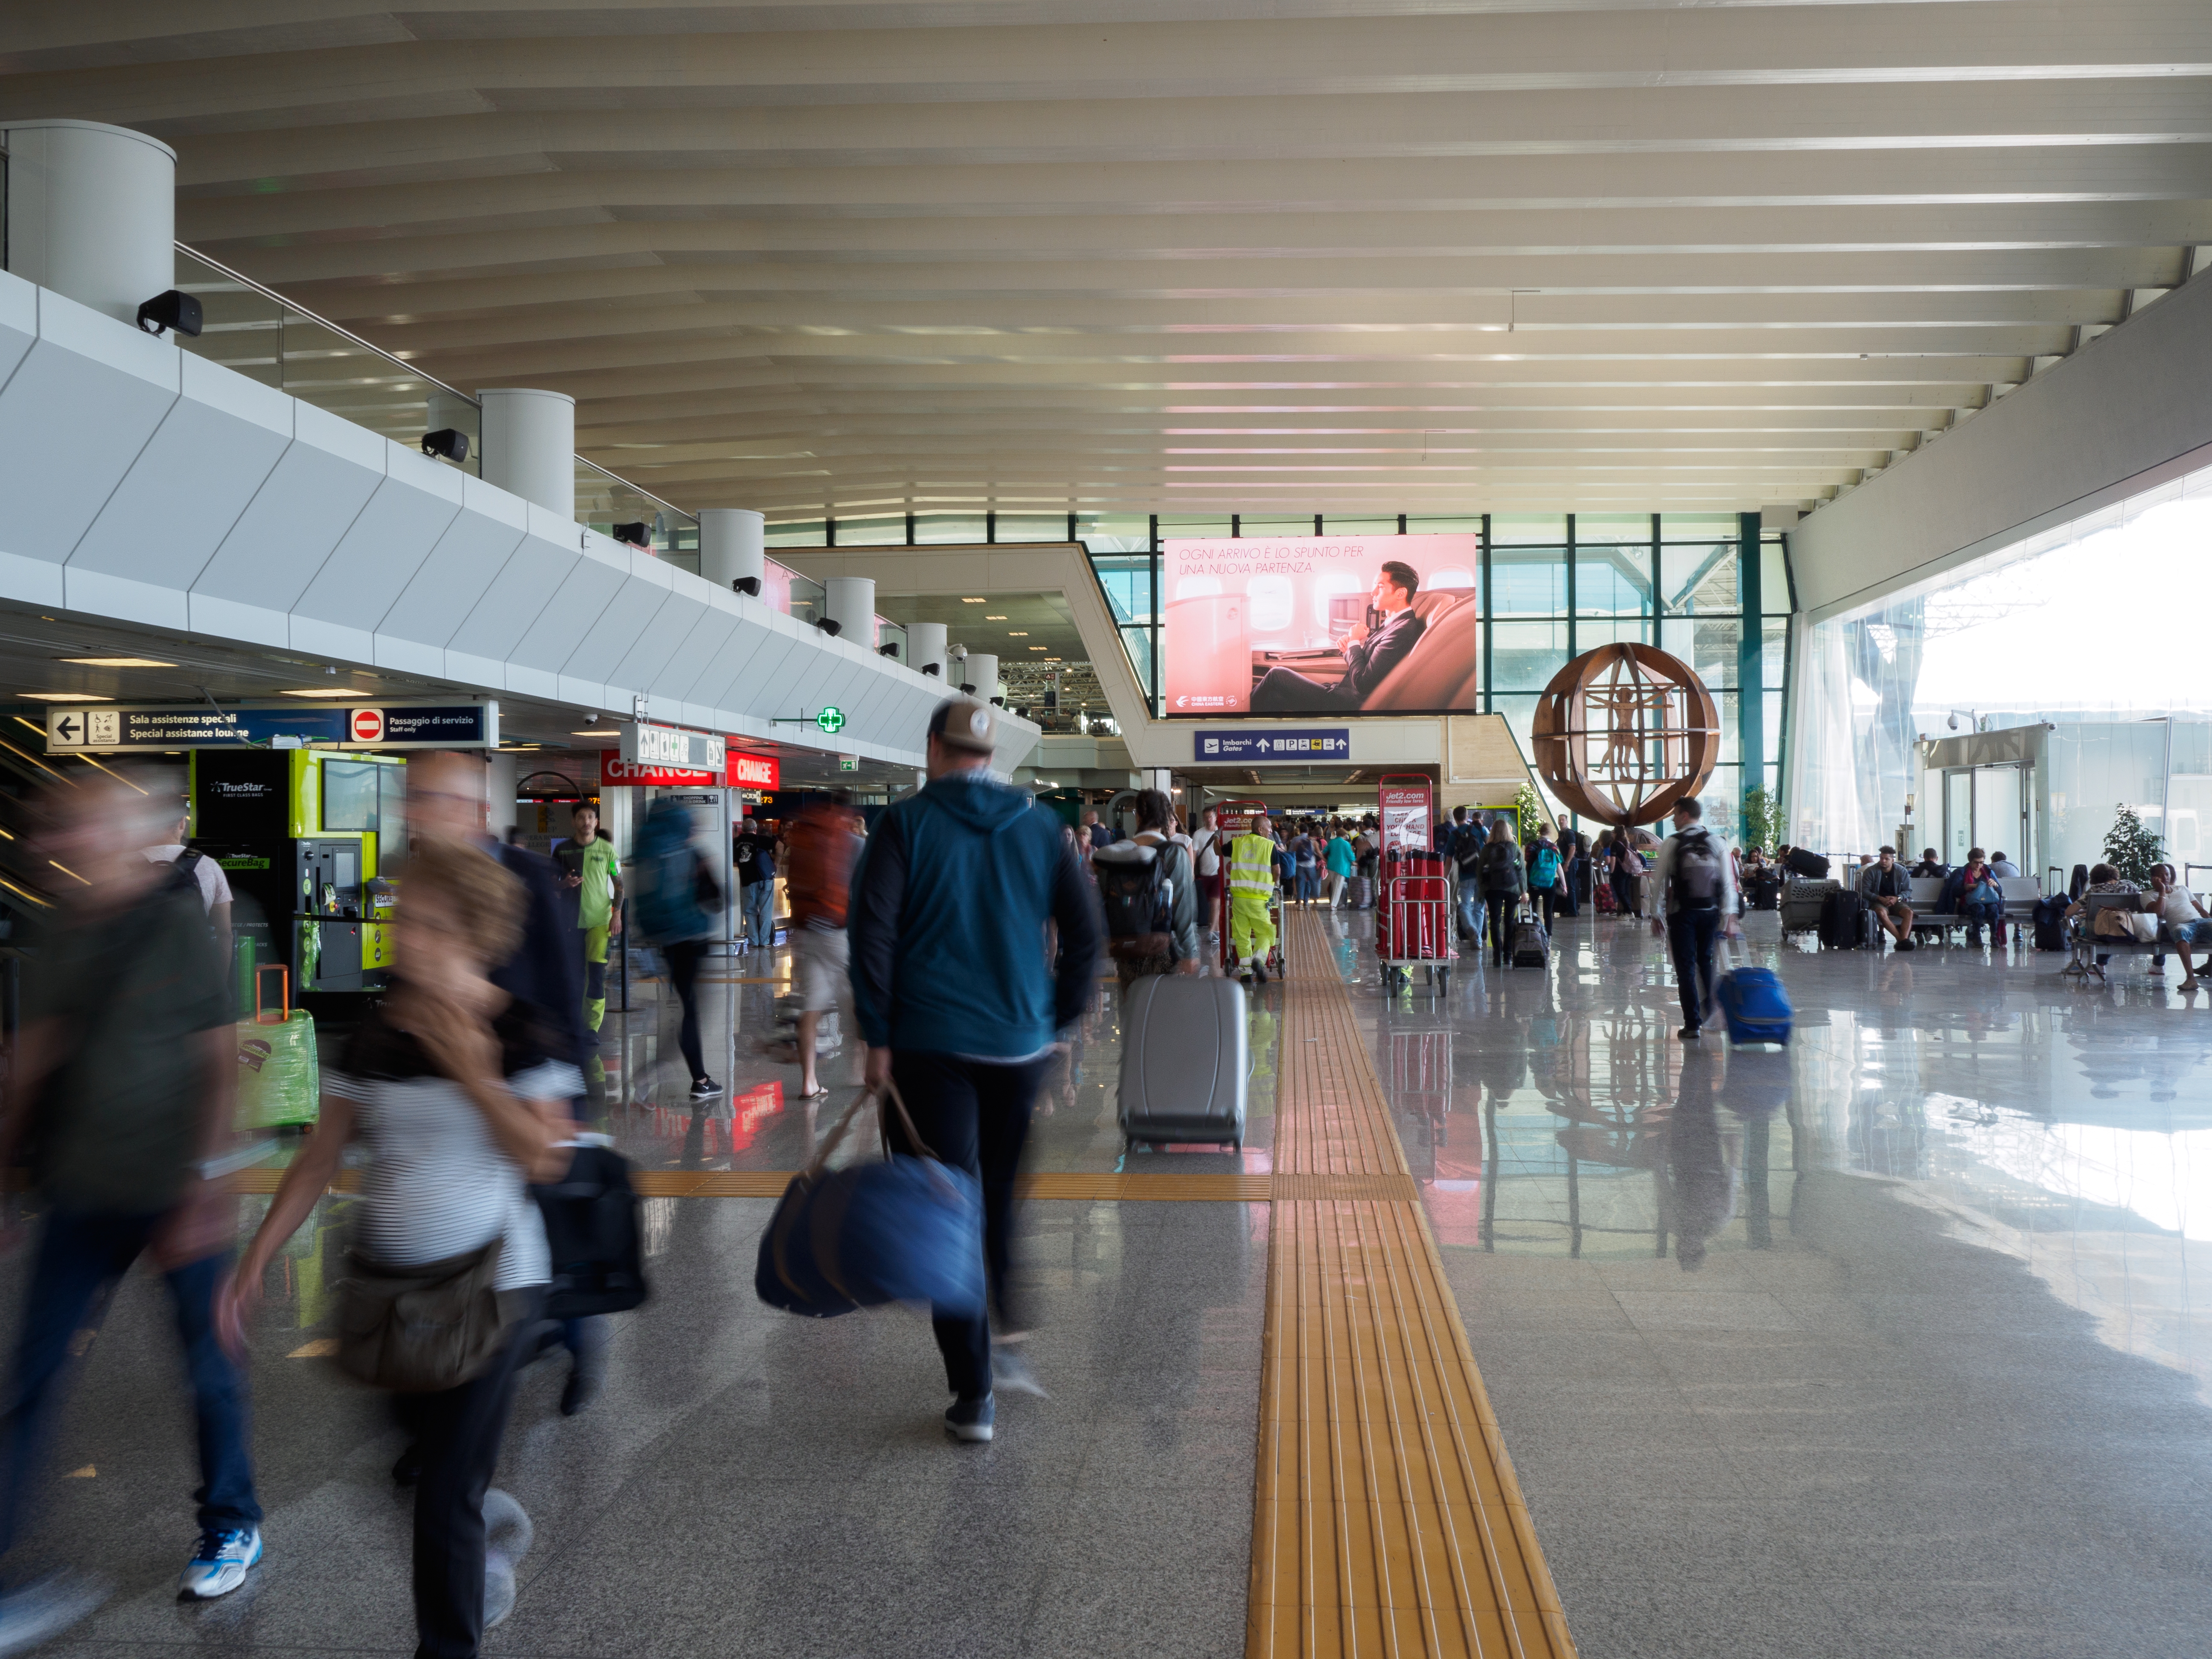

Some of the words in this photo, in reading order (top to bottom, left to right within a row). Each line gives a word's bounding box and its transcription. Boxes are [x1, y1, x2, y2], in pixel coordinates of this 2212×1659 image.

[1179, 549, 1214, 560] OGNI
[1218, 548, 1260, 559] ARRIVO
[1264, 546, 1271, 559] È
[1275, 547, 1289, 559] LO
[1294, 547, 1339, 558] SPUNTO
[1344, 546, 1364, 557] PER
[1179, 564, 1204, 575] UNA
[1209, 563, 1250, 574] NUOVA
[1255, 562, 1315, 574] PARTENZA.
[130, 715, 149, 724] Sala
[152, 715, 199, 724] assistenze
[390, 717, 430, 726] Passaggio
[130, 729, 163, 739] Special
[166, 729, 213, 737] assistance
[737, 759, 771, 783] CHANGE
[222, 783, 263, 792] TrueStar
[217, 859, 265, 869] SecureBag
[376, 894, 393, 903] SECURE
